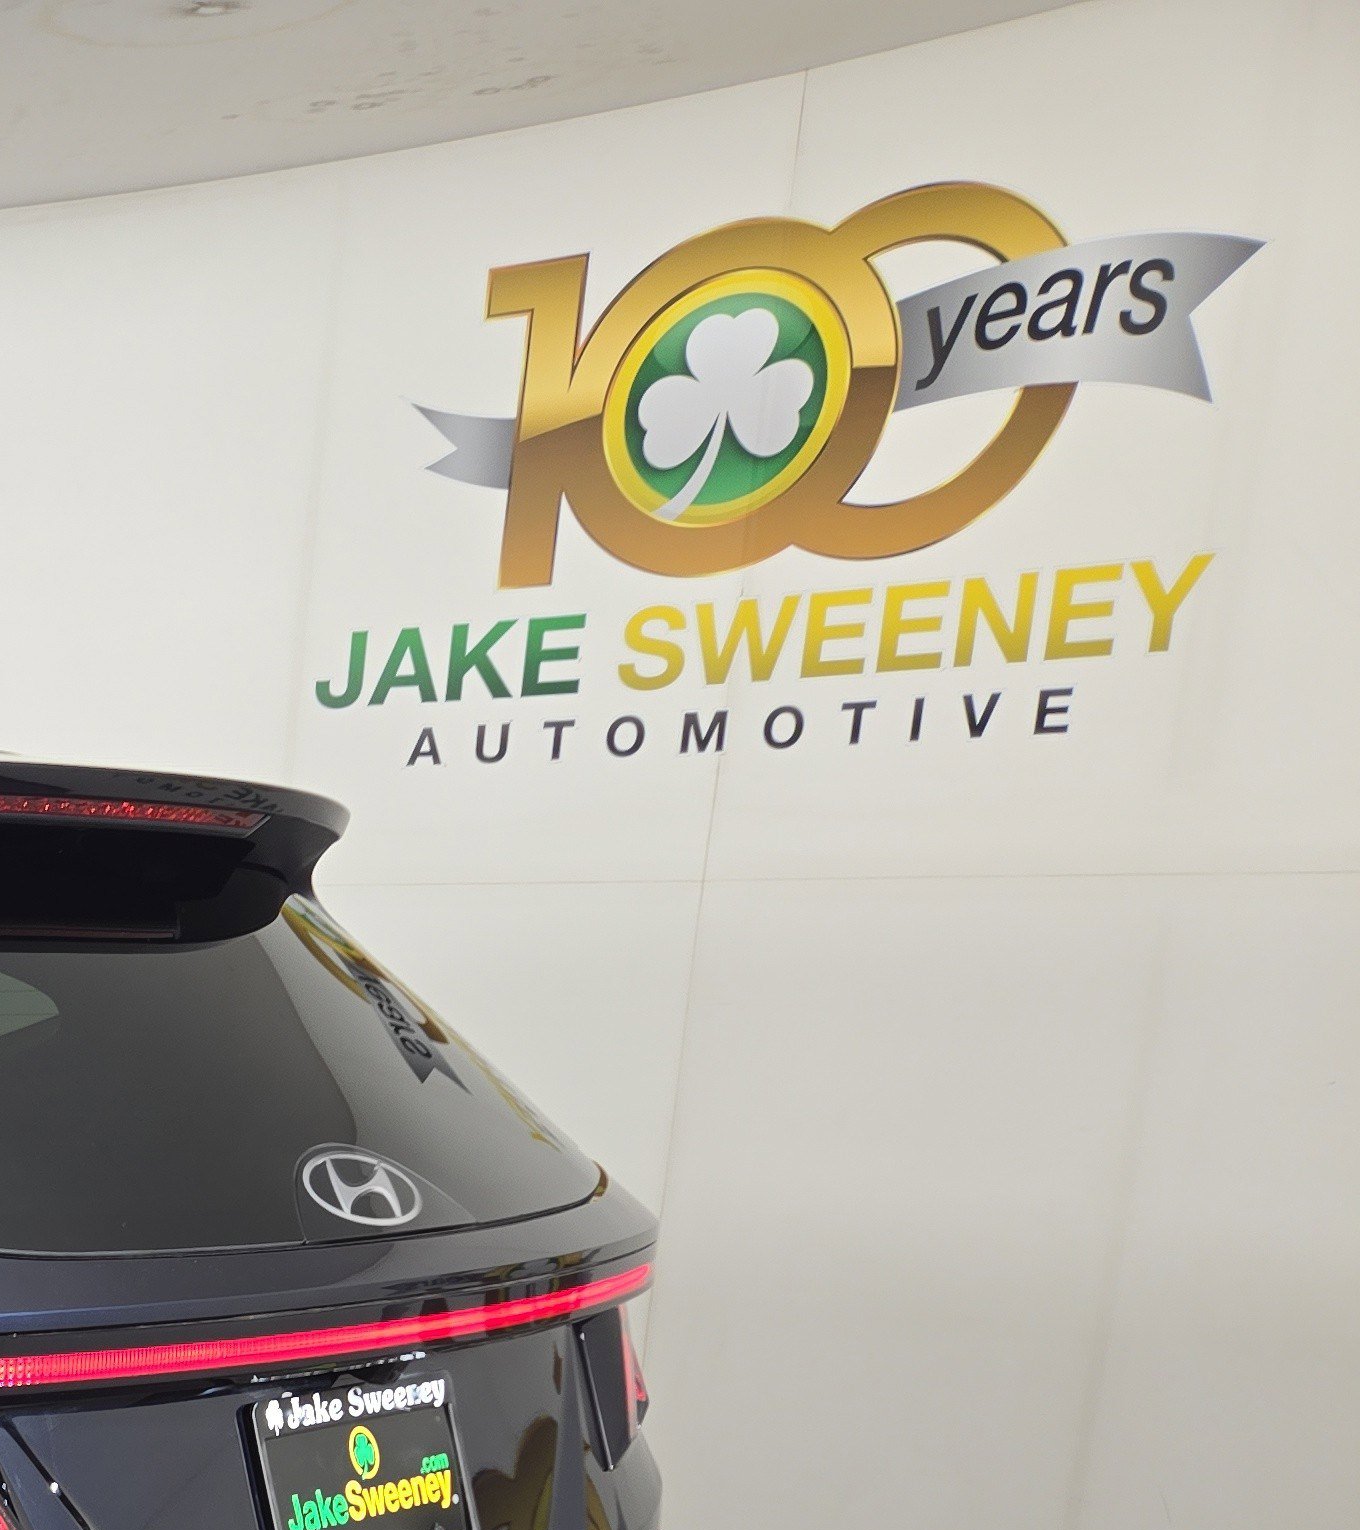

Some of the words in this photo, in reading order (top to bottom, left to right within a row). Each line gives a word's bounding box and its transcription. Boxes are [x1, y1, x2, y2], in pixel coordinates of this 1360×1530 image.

[914, 254, 1176, 392] years
[314, 612, 588, 710] JAKE
[617, 552, 1215, 692] SWEENEY
[406, 686, 1075, 767] AUTOMOTIVE
[287, 1391, 344, 1430] Jake
[347, 1378, 446, 1418] Sweeney
[419, 1452, 450, 1475] .com
